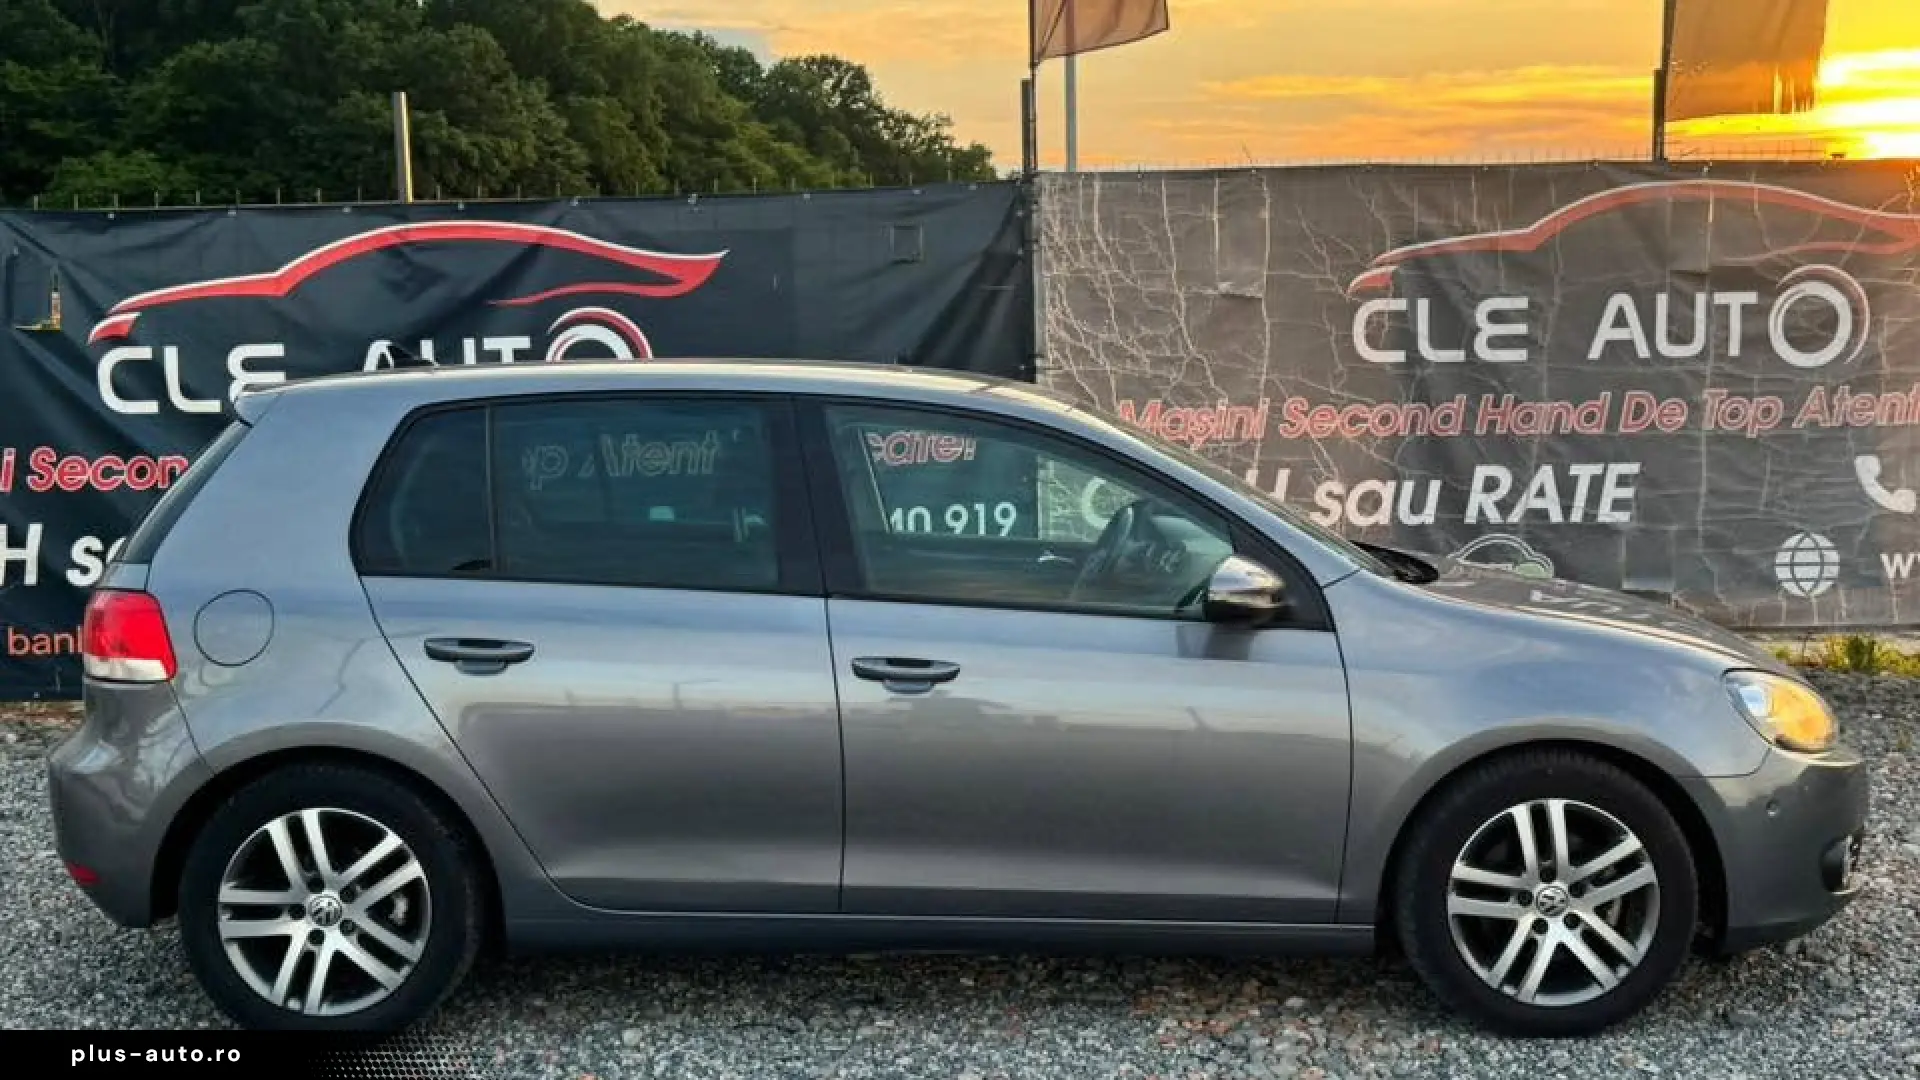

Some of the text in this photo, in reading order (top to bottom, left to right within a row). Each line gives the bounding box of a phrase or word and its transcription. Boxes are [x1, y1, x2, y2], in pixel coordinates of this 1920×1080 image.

[1352, 281, 1854, 368] CLE AUTO
[97, 344, 286, 414] CLE
[1279, 394, 1467, 438] Second
[1475, 391, 1612, 436] Hand
[1618, 390, 1689, 433] De
[1702, 387, 1785, 439] Top
[26, 446, 189, 492] Secon
[1309, 479, 1441, 526] sau
[1463, 462, 1642, 525] RATE
[943, 501, 1017, 536] 919
